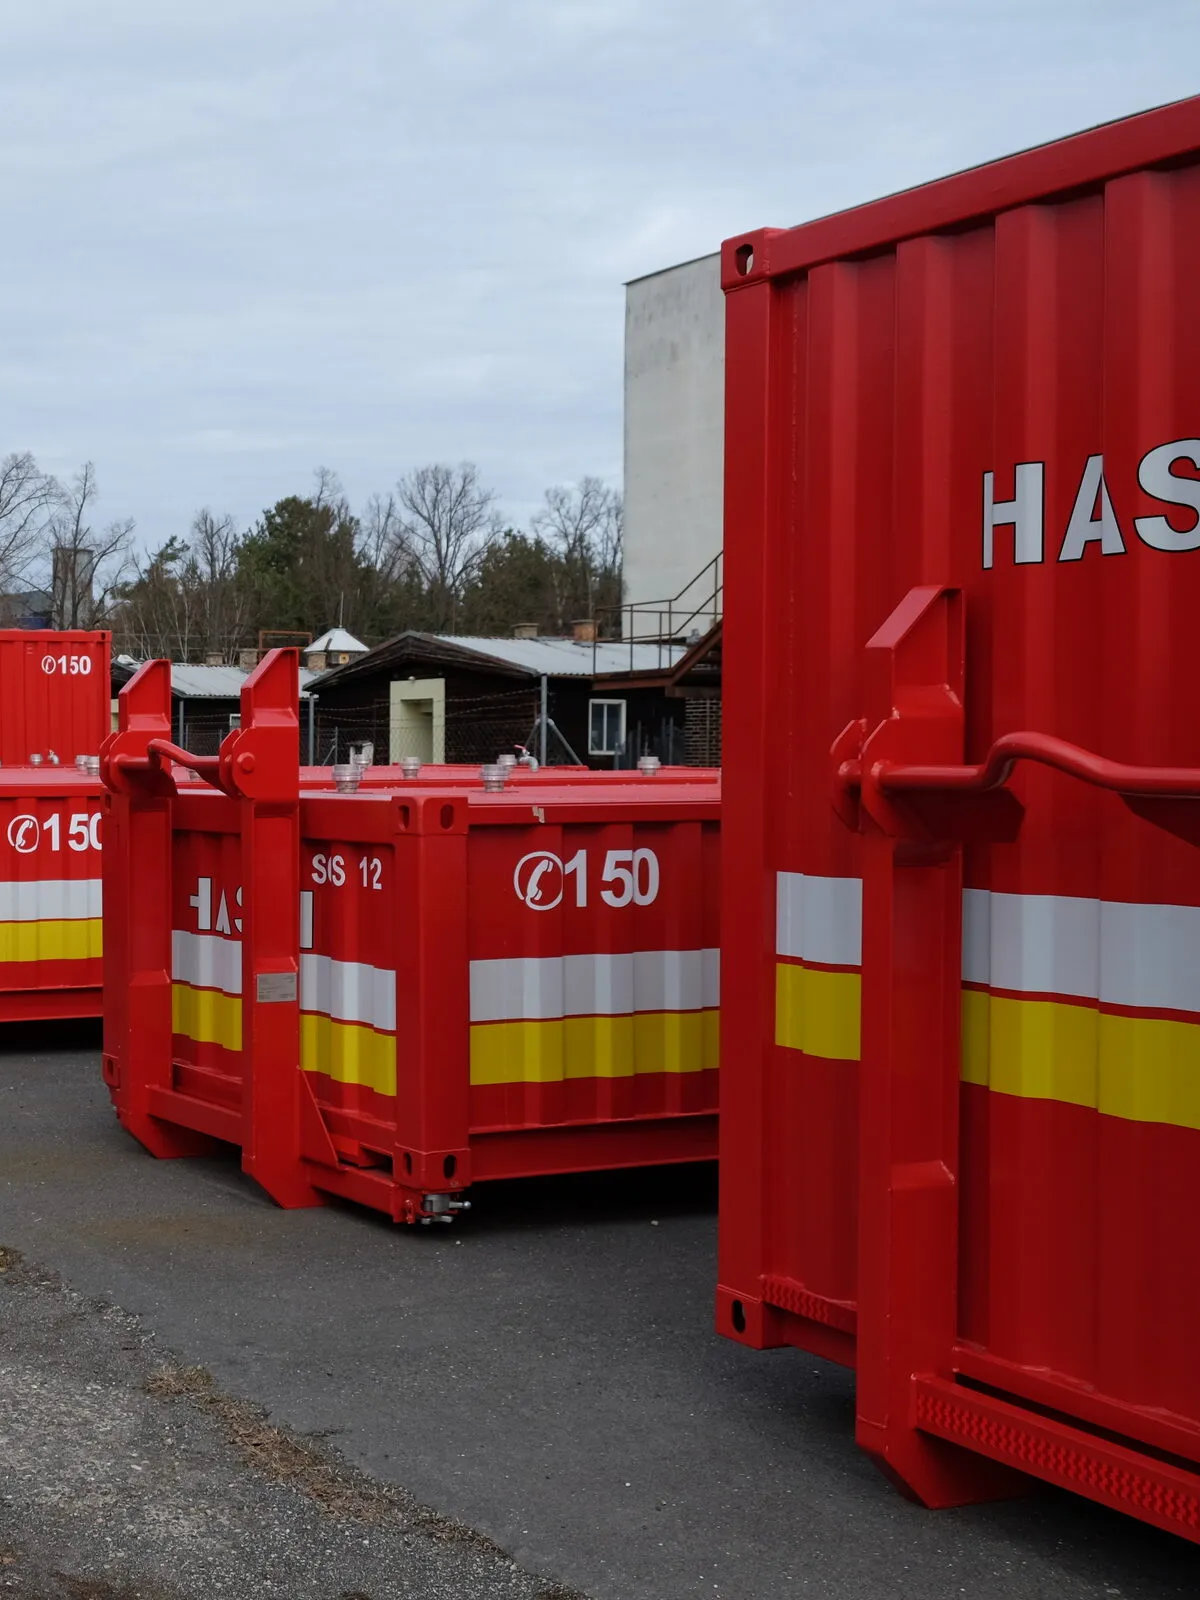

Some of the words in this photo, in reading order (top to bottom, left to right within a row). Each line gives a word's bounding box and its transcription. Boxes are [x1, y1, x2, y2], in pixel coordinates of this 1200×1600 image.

[57, 655, 92, 675] 150
[311, 853, 346, 887] SS
[564, 847, 660, 908] 150
